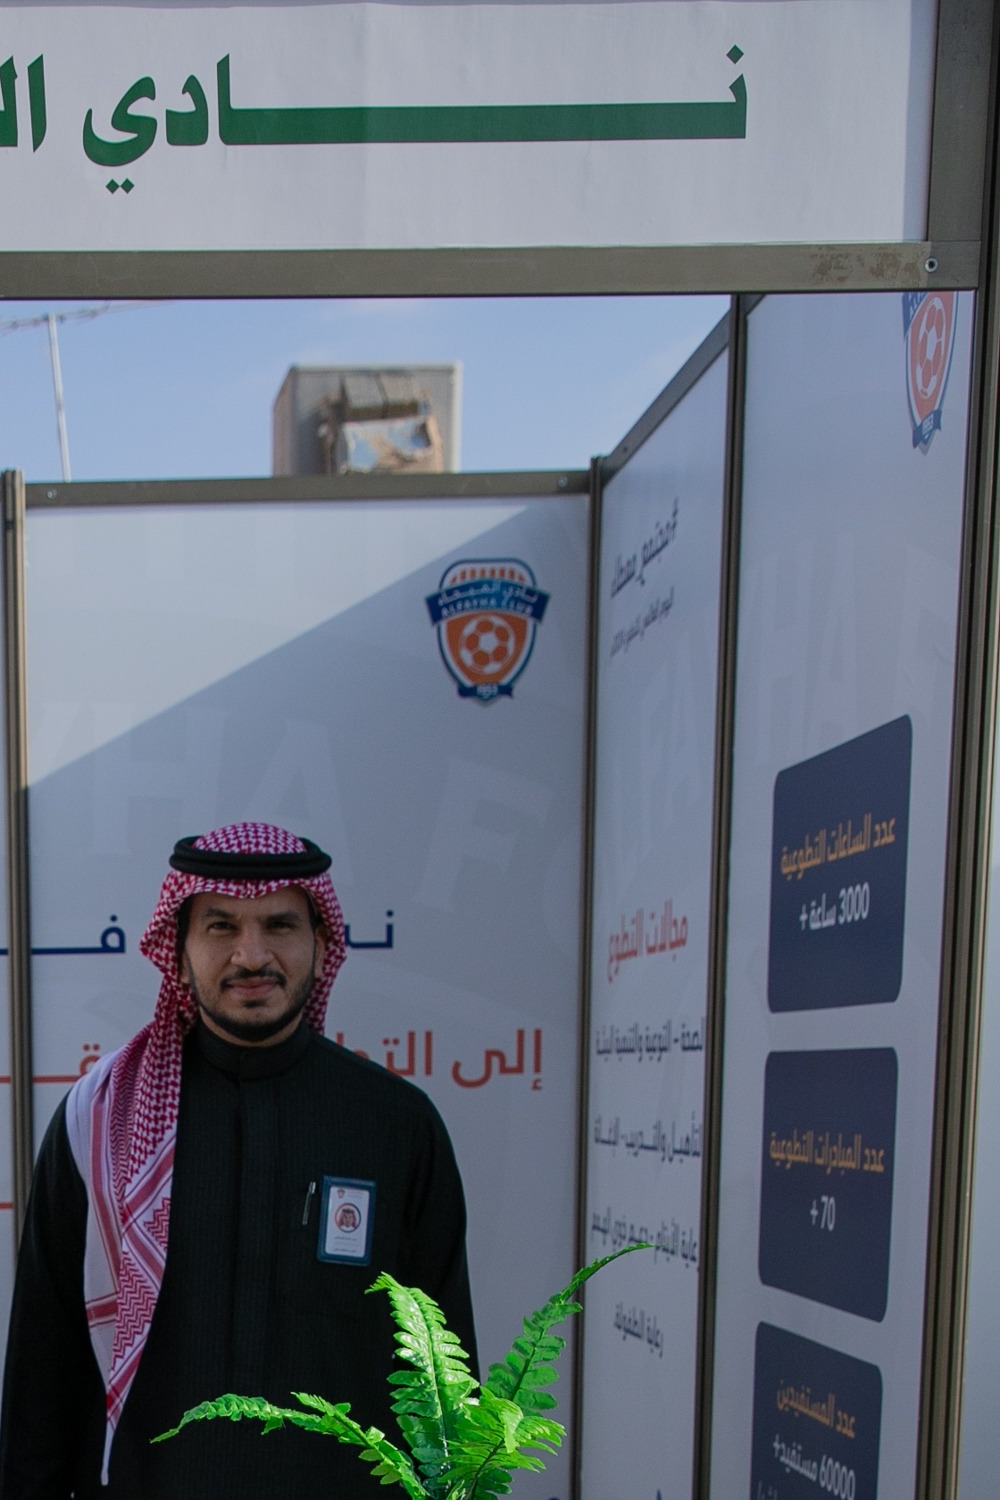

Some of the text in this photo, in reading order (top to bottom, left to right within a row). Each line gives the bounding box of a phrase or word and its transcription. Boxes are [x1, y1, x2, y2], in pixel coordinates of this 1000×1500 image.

[83, 47, 747, 194] نادي
[781, 812, 896, 881] عدد الساعات التطوعية
[838, 881, 870, 925] 3000
[452, 1028, 542, 1090] إلى
[769, 1128, 814, 1170] التطوعية
[863, 1147, 885, 1173] عدد
[836, 1409, 855, 1439] عدد
